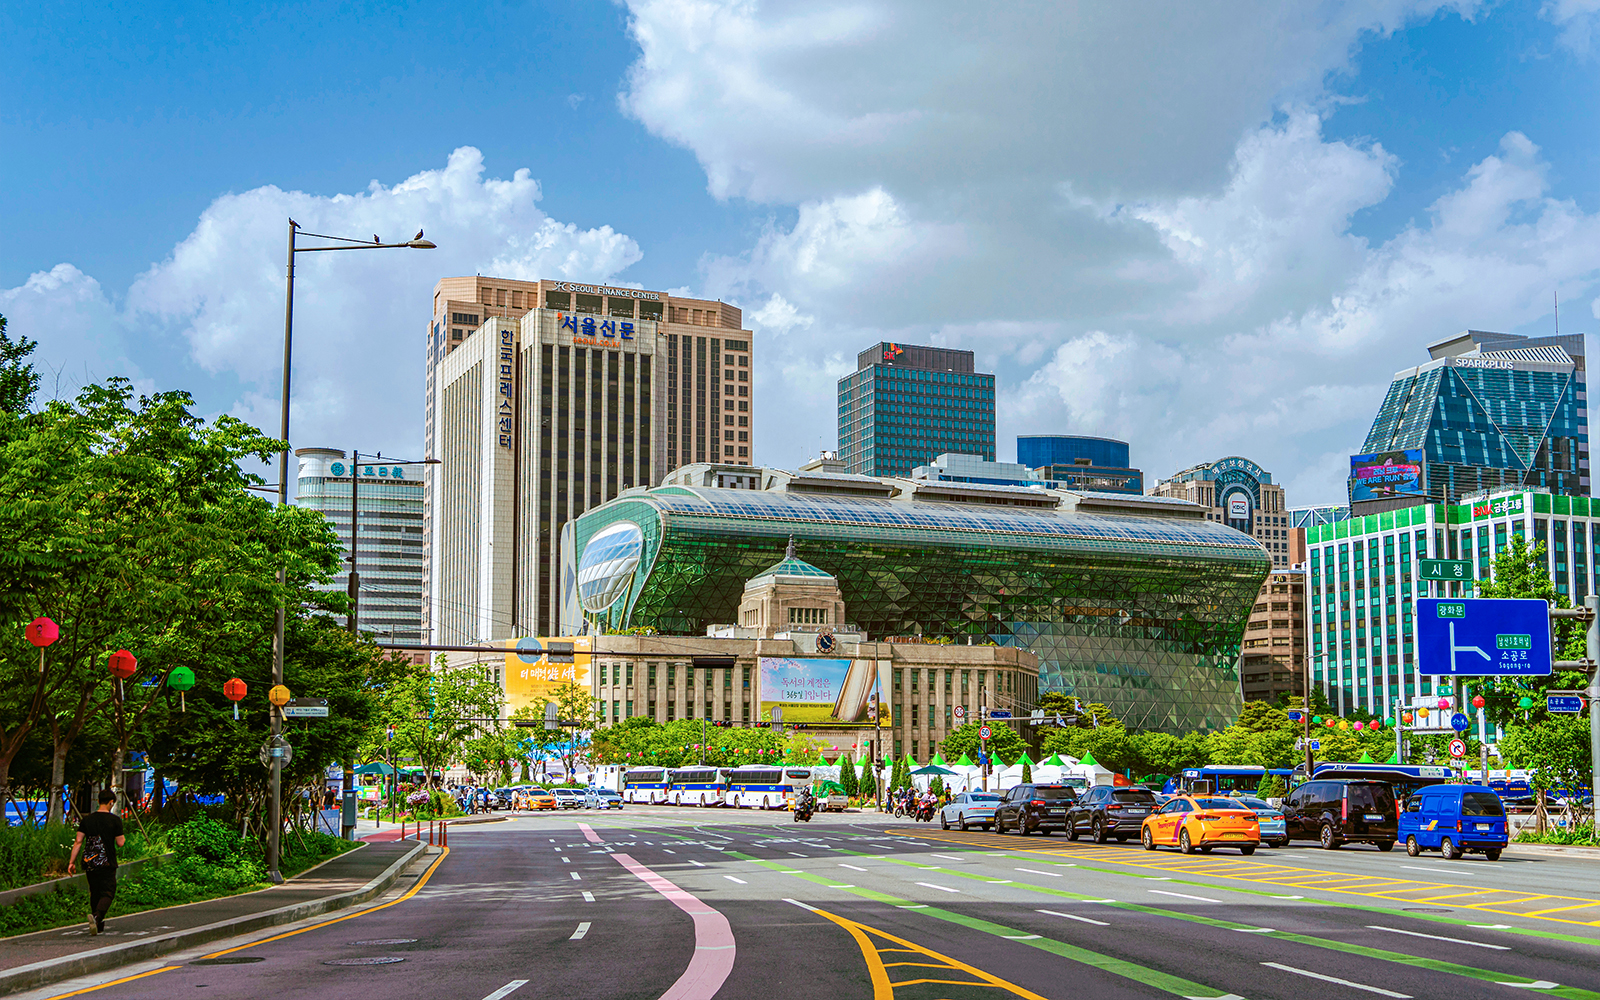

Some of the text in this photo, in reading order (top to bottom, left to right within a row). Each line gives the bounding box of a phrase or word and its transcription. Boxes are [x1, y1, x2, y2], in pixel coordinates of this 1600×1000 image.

[569, 283, 596, 294] SEOUL
[597, 286, 631, 298] FINANCE
[631, 291, 660, 300] CENTER
[561, 315, 635, 340] 서울신문
[573, 336, 621, 348] seoul.co.kr
[883, 351, 895, 361] SK
[499, 329, 514, 450] 한국프레스센터
[1211, 460, 1261, 477] 예금보험공사
[1367, 476, 1382, 485] ARE
[1473, 498, 1523, 517] BNK 금융그룹
[1439, 605, 1463, 616] 광화문
[1501, 650, 1528, 662] 소공로
[1498, 661, 1531, 670] Sogong-ro
[781, 677, 832, 689] 독서의 계절은
[981, 728, 990, 737] 50
